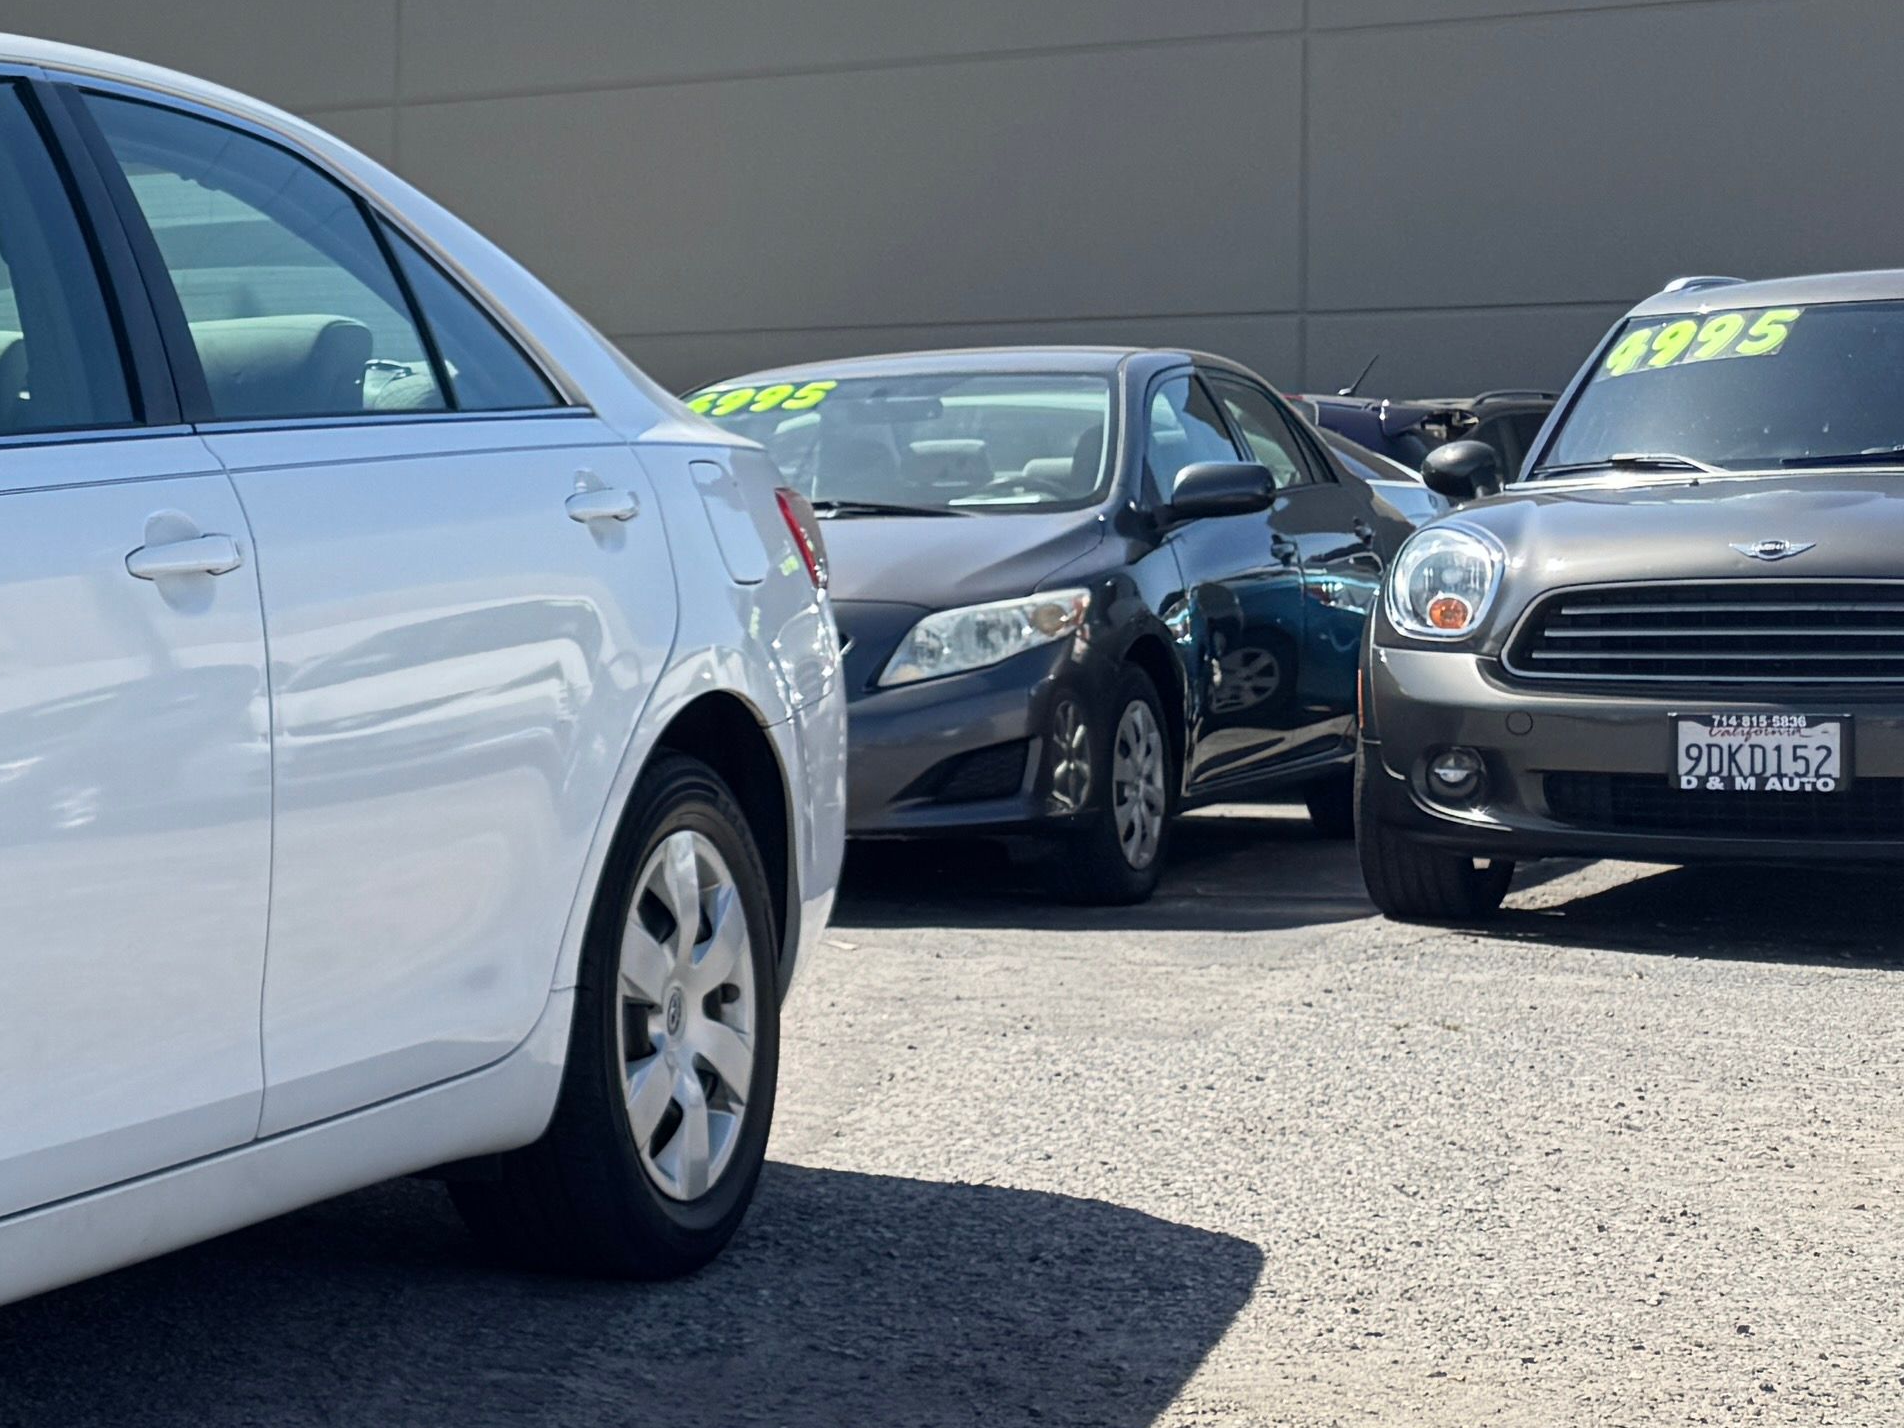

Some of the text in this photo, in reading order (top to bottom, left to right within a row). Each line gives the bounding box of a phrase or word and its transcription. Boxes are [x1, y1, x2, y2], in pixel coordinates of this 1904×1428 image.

[1606, 308, 1801, 377] 4995
[1684, 742, 1833, 778] 9DKD152
[1680, 775, 1836, 792] D & M AUTO
